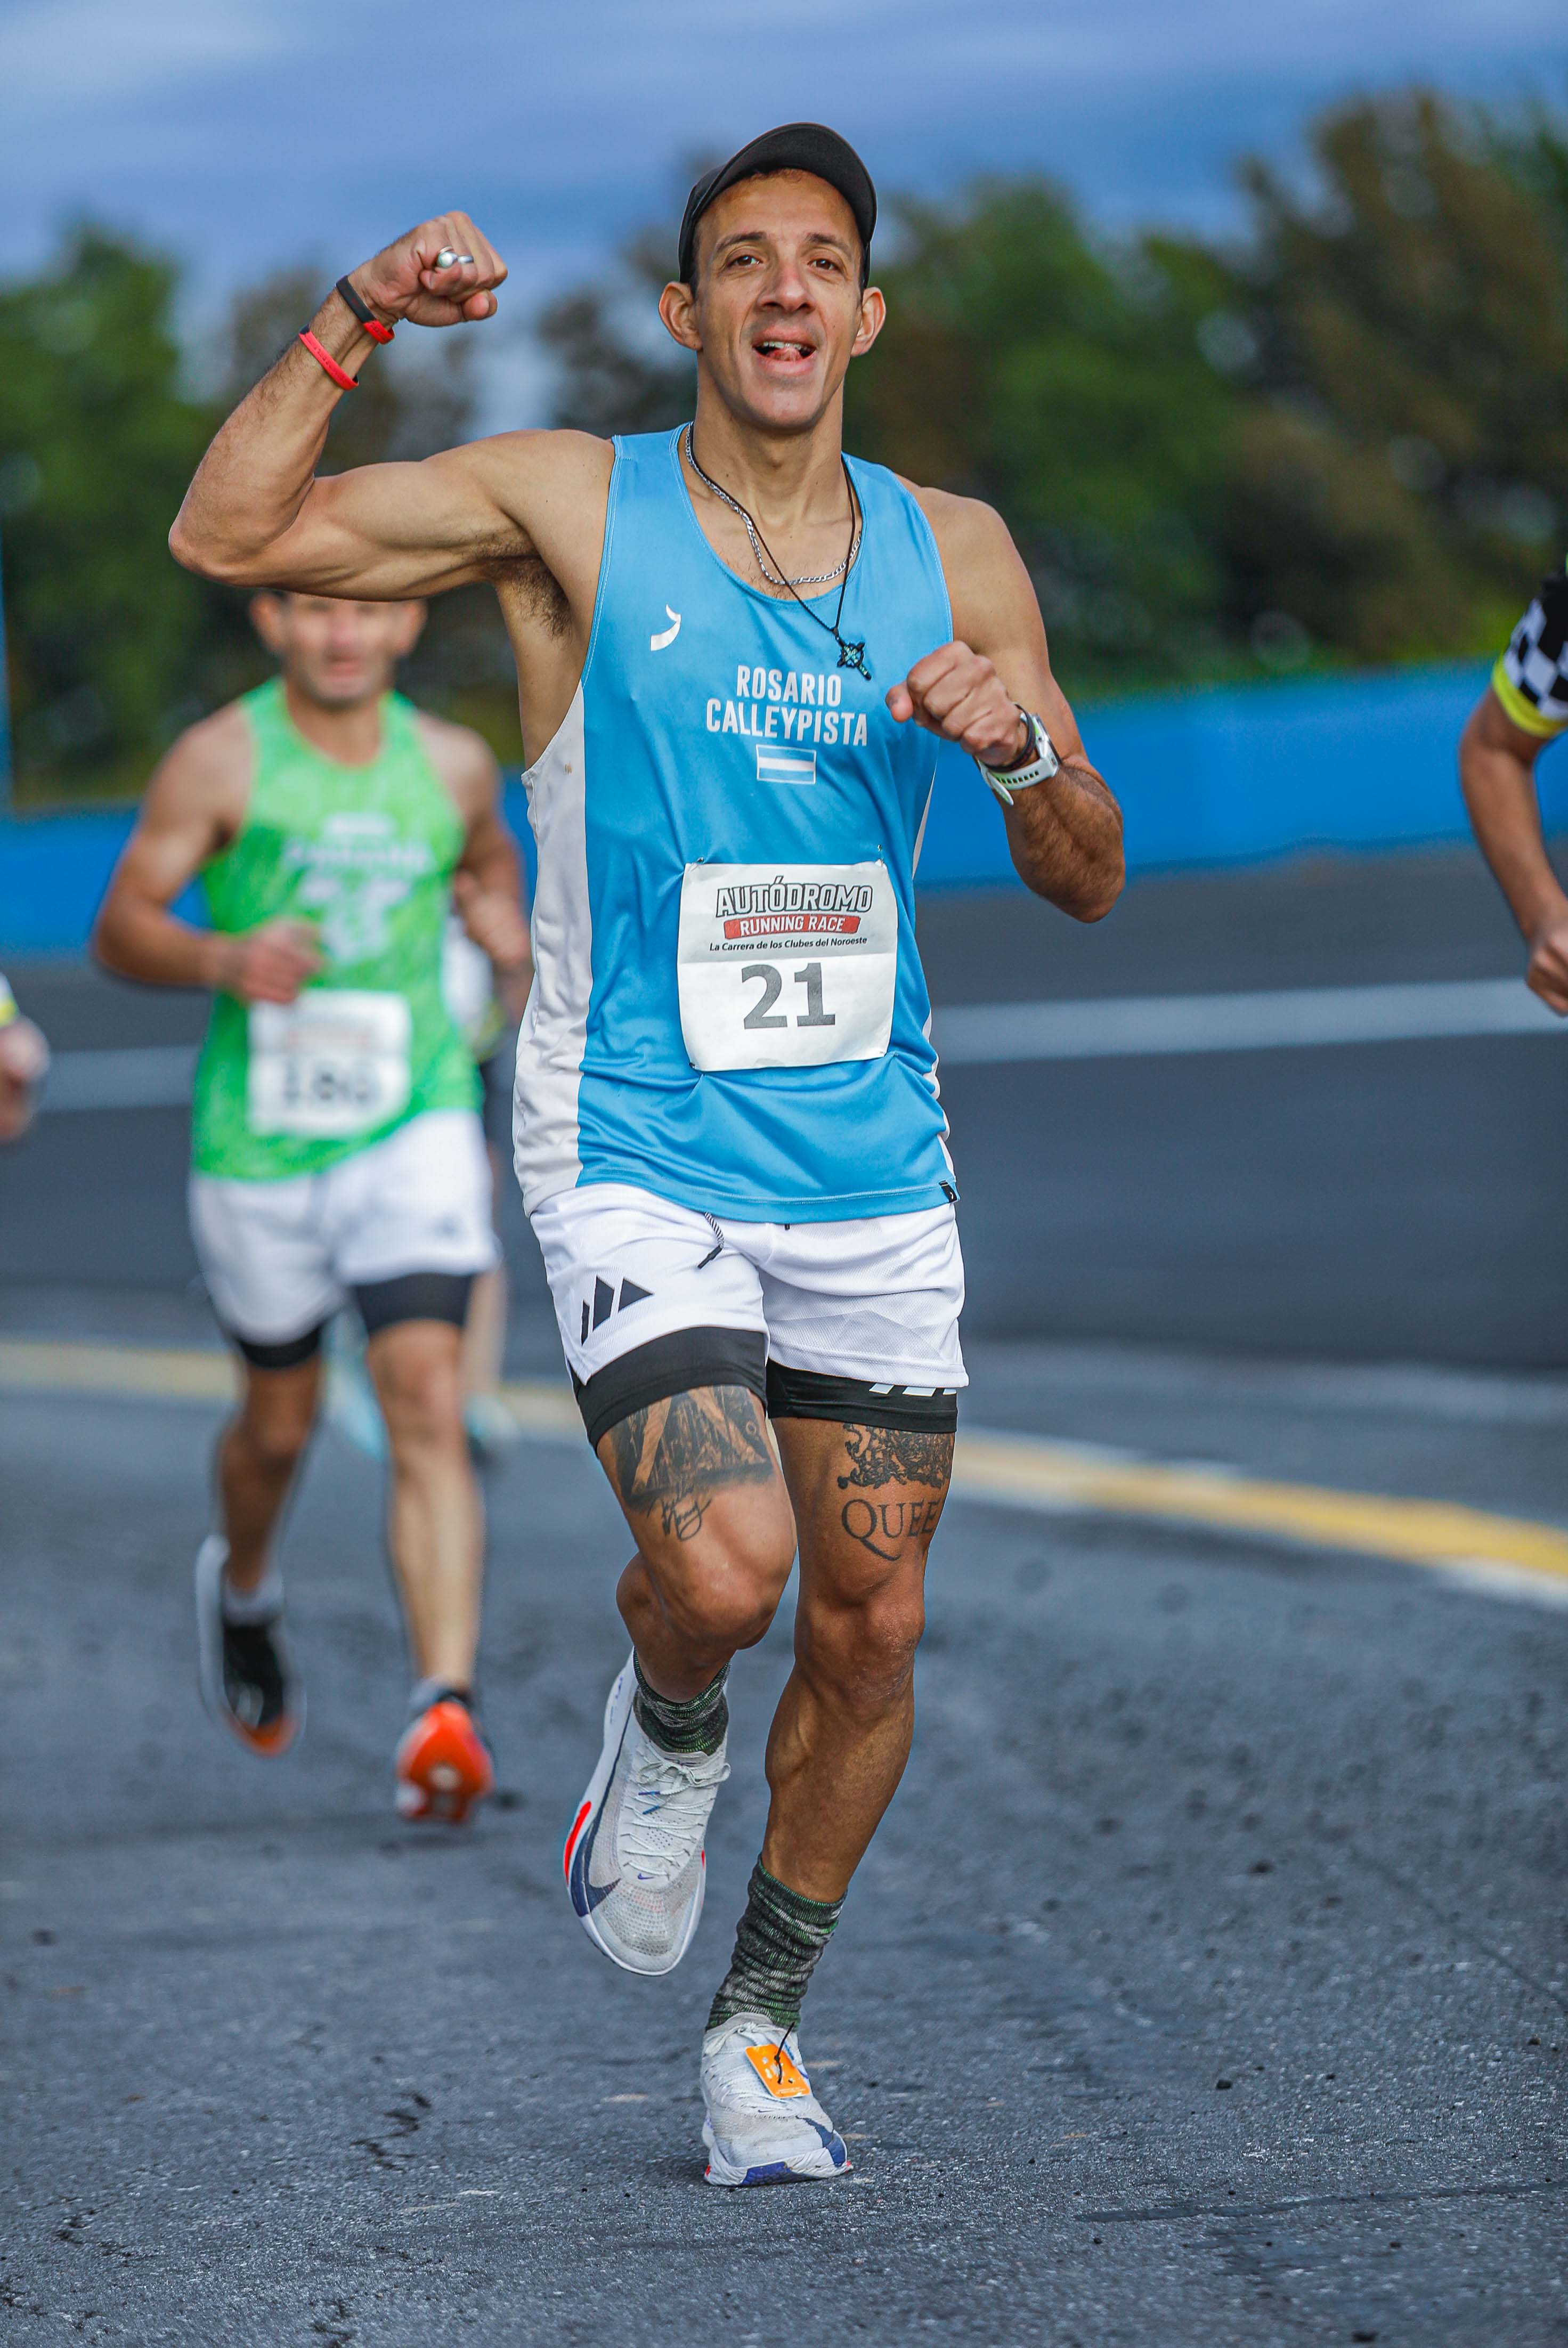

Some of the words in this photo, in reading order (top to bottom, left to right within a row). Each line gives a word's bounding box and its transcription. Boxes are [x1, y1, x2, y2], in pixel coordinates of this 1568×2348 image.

[737, 665, 841, 706] ROSARIO
[706, 698, 867, 746] CALLEYPISTA
[716, 875, 873, 917] AUTÓDROMO
[710, 943, 719, 951] La
[722, 943, 754, 951] Carrera
[785, 938, 814, 948] Clubes
[815, 938, 829, 947] del
[831, 937, 867, 946] Noroeste
[740, 918, 804, 936] RUNNING
[808, 917, 846, 932] RACE
[741, 962, 835, 1029] 21
